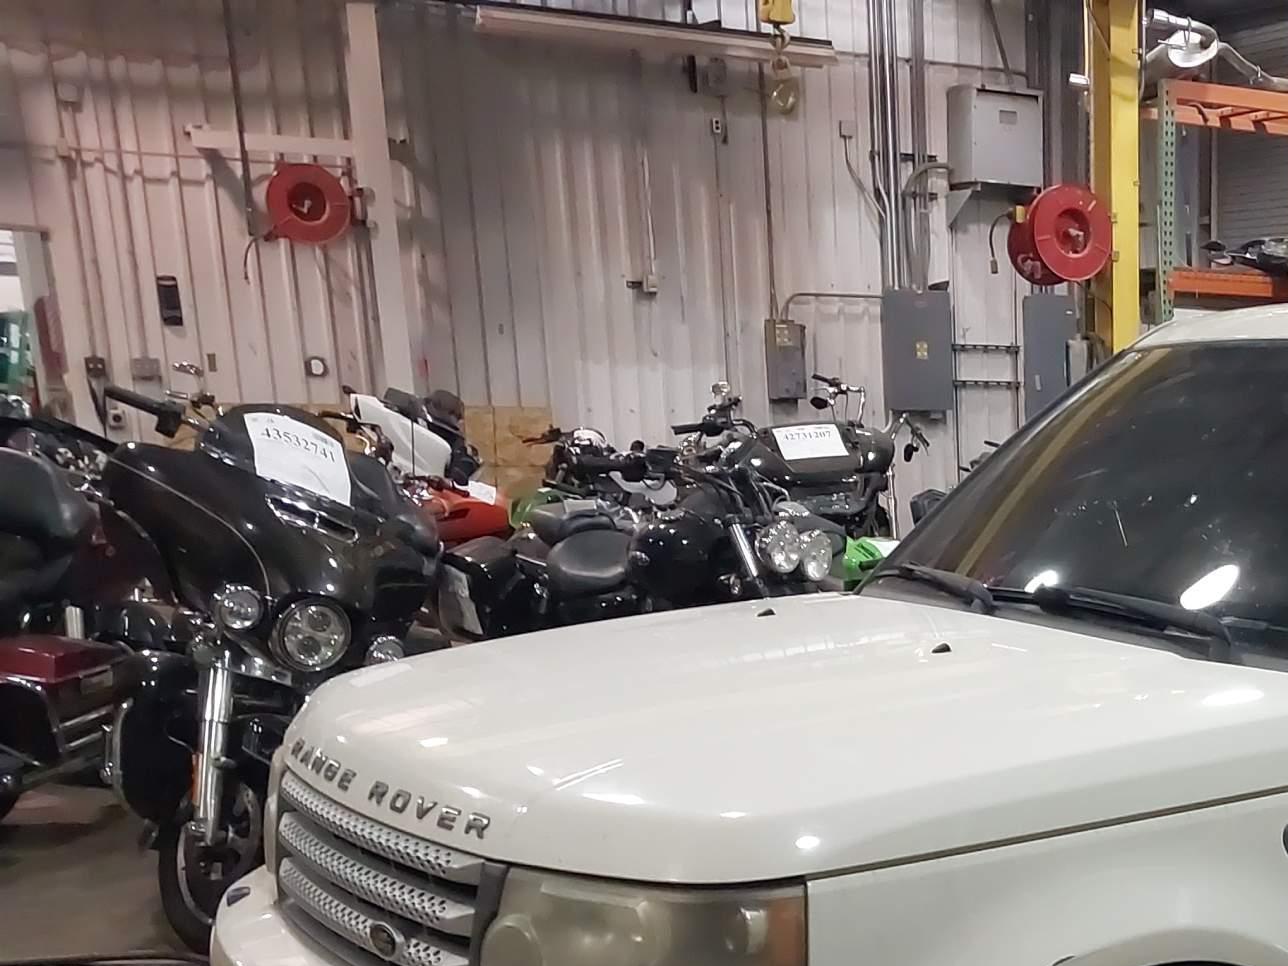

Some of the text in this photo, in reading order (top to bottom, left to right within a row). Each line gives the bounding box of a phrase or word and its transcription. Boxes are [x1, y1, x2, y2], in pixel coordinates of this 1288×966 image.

[260, 427, 336, 463] 43532741
[290, 738, 490, 840] RANGE ROVER
